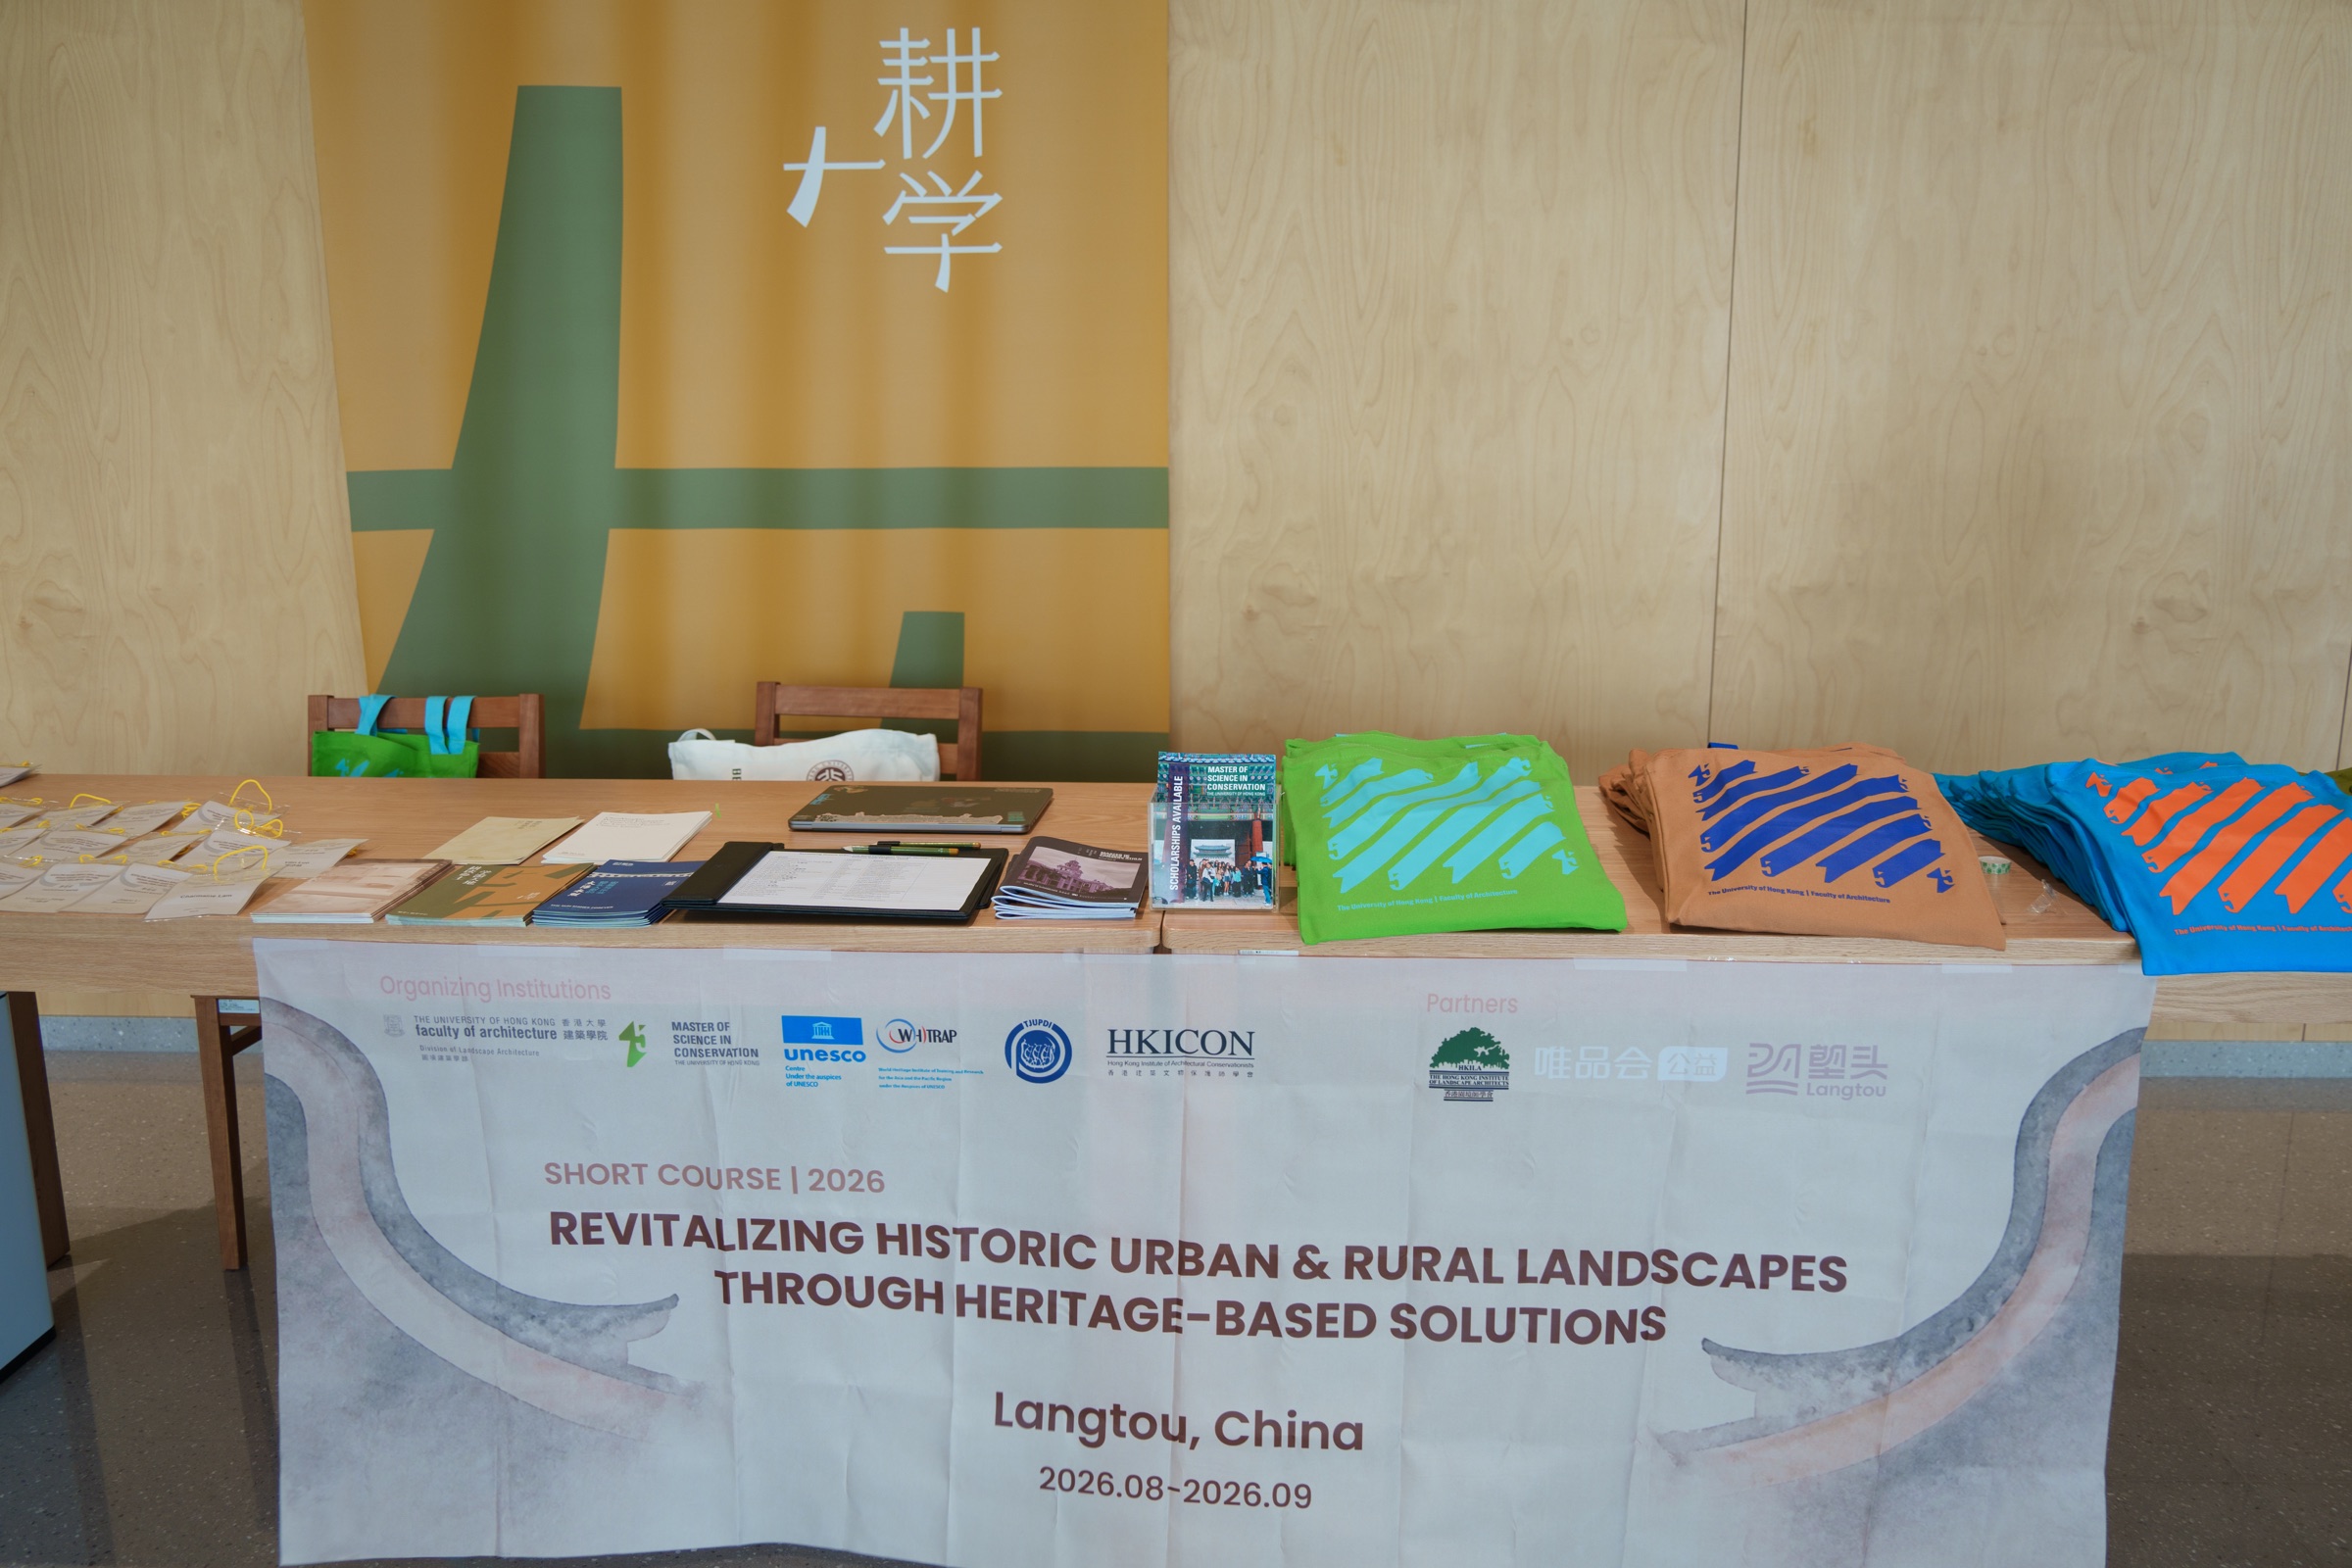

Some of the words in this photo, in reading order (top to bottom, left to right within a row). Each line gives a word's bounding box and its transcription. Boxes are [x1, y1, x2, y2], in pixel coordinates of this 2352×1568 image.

[1172, 775, 1184, 823] AVAILABLE
[1169, 824, 1181, 891] SCHOLARSHIPS
[1350, 902, 1387, 910] University
[1474, 889, 1518, 899] Architecture
[1721, 884, 1758, 894] University
[1767, 886, 1787, 895] Hong
[1810, 890, 1838, 900] Faculty
[1845, 894, 1890, 904] Architecture
[2189, 924, 2228, 934] University
[380, 975, 492, 1003] Organizing
[498, 978, 612, 1000] Institutions
[1426, 993, 1519, 1013] Partners
[414, 1015, 431, 1024] THE
[433, 1015, 486, 1025] UNIVERSITY
[489, 1016, 501, 1025] OF
[504, 1016, 528, 1026] HONG
[531, 1017, 556, 1027] KONG
[562, 1018, 608, 1028] 香港大學
[671, 1021, 715, 1032] MASTER
[716, 1021, 730, 1032] OF
[1023, 1018, 1053, 1029] TJUPDI
[416, 1024, 460, 1039] faculty
[464, 1025, 476, 1038] of
[479, 1025, 558, 1040] architecture
[673, 1034, 717, 1046] SCIENCE
[719, 1035, 732, 1045] IN
[459, 1046, 495, 1055] Landscape
[497, 1048, 540, 1057] Architecture
[1107, 1029, 1255, 1056] HKICON
[674, 1048, 760, 1058] CONSERVATION
[784, 1048, 867, 1063] unesco
[1534, 1046, 1654, 1080] 唯品会
[1667, 1052, 1718, 1077] 公益
[1124, 1059, 1140, 1068] Kong
[1806, 1082, 1887, 1102] Langtou
[544, 1161, 649, 1186] SHORT
[658, 1163, 782, 1192] COURSE
[808, 1167, 886, 1194] 2026
[550, 1210, 865, 1255] REVITALIZING
[877, 1222, 1097, 1270] HISTORIC
[1111, 1237, 1279, 1279] URBAN
[1292, 1244, 1332, 1281] &
[1345, 1245, 1504, 1285] RURAL
[1517, 1248, 1848, 1294] LANDSCAPES
[713, 1269, 945, 1315] THROUGH
[1390, 1304, 1667, 1346] SOLUTIONS
[995, 1391, 1201, 1451] Langtou,
[1214, 1408, 1363, 1451] China
